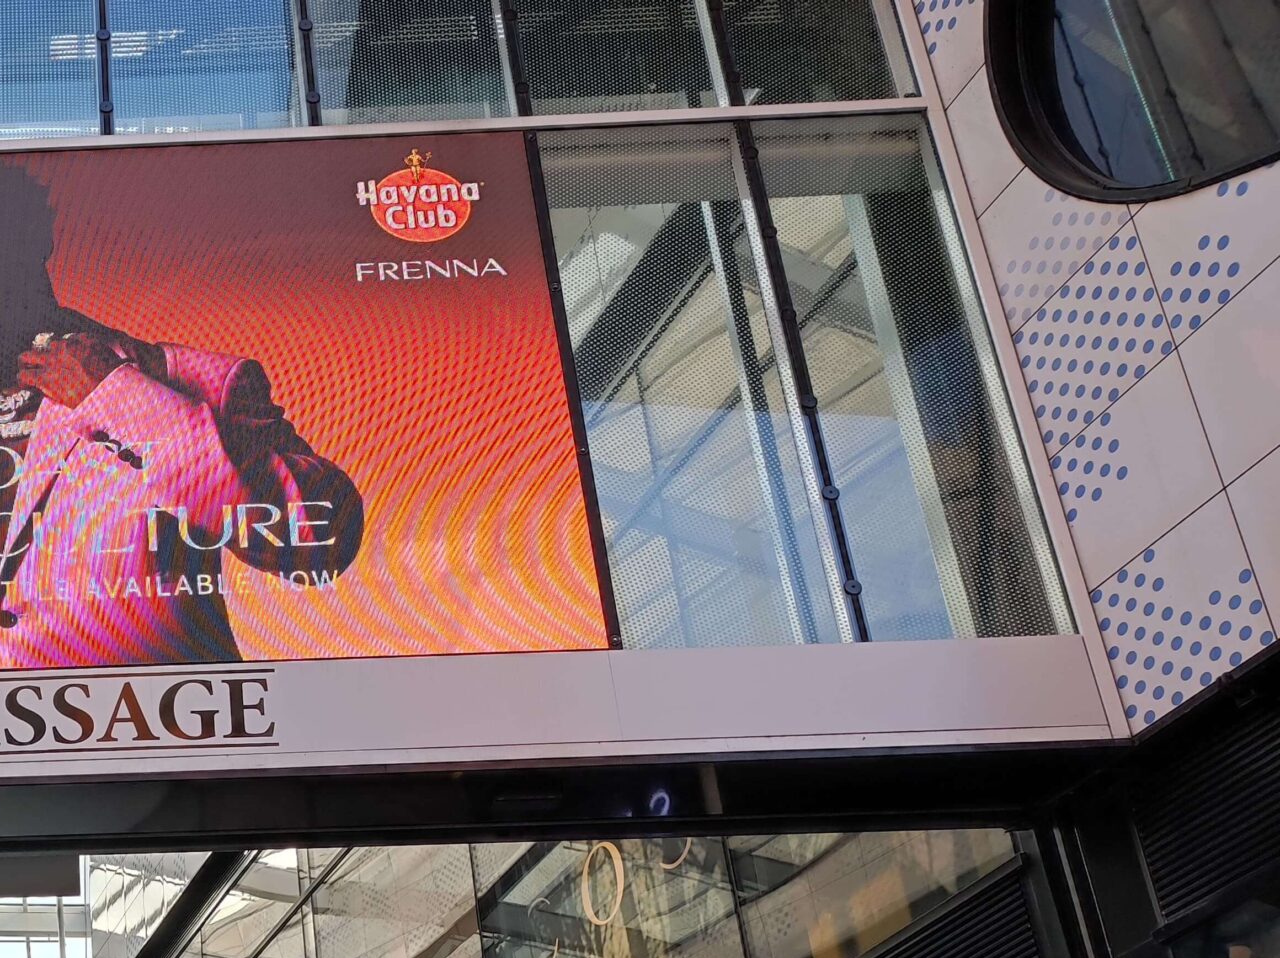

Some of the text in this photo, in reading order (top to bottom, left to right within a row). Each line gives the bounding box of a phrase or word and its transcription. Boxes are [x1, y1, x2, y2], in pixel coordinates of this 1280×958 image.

[356, 180, 481, 206] Havana
[385, 204, 458, 229] Club
[356, 258, 508, 282] FRENNA
[86, 573, 257, 600] AVAILABLE
[268, 569, 340, 593] NOW
